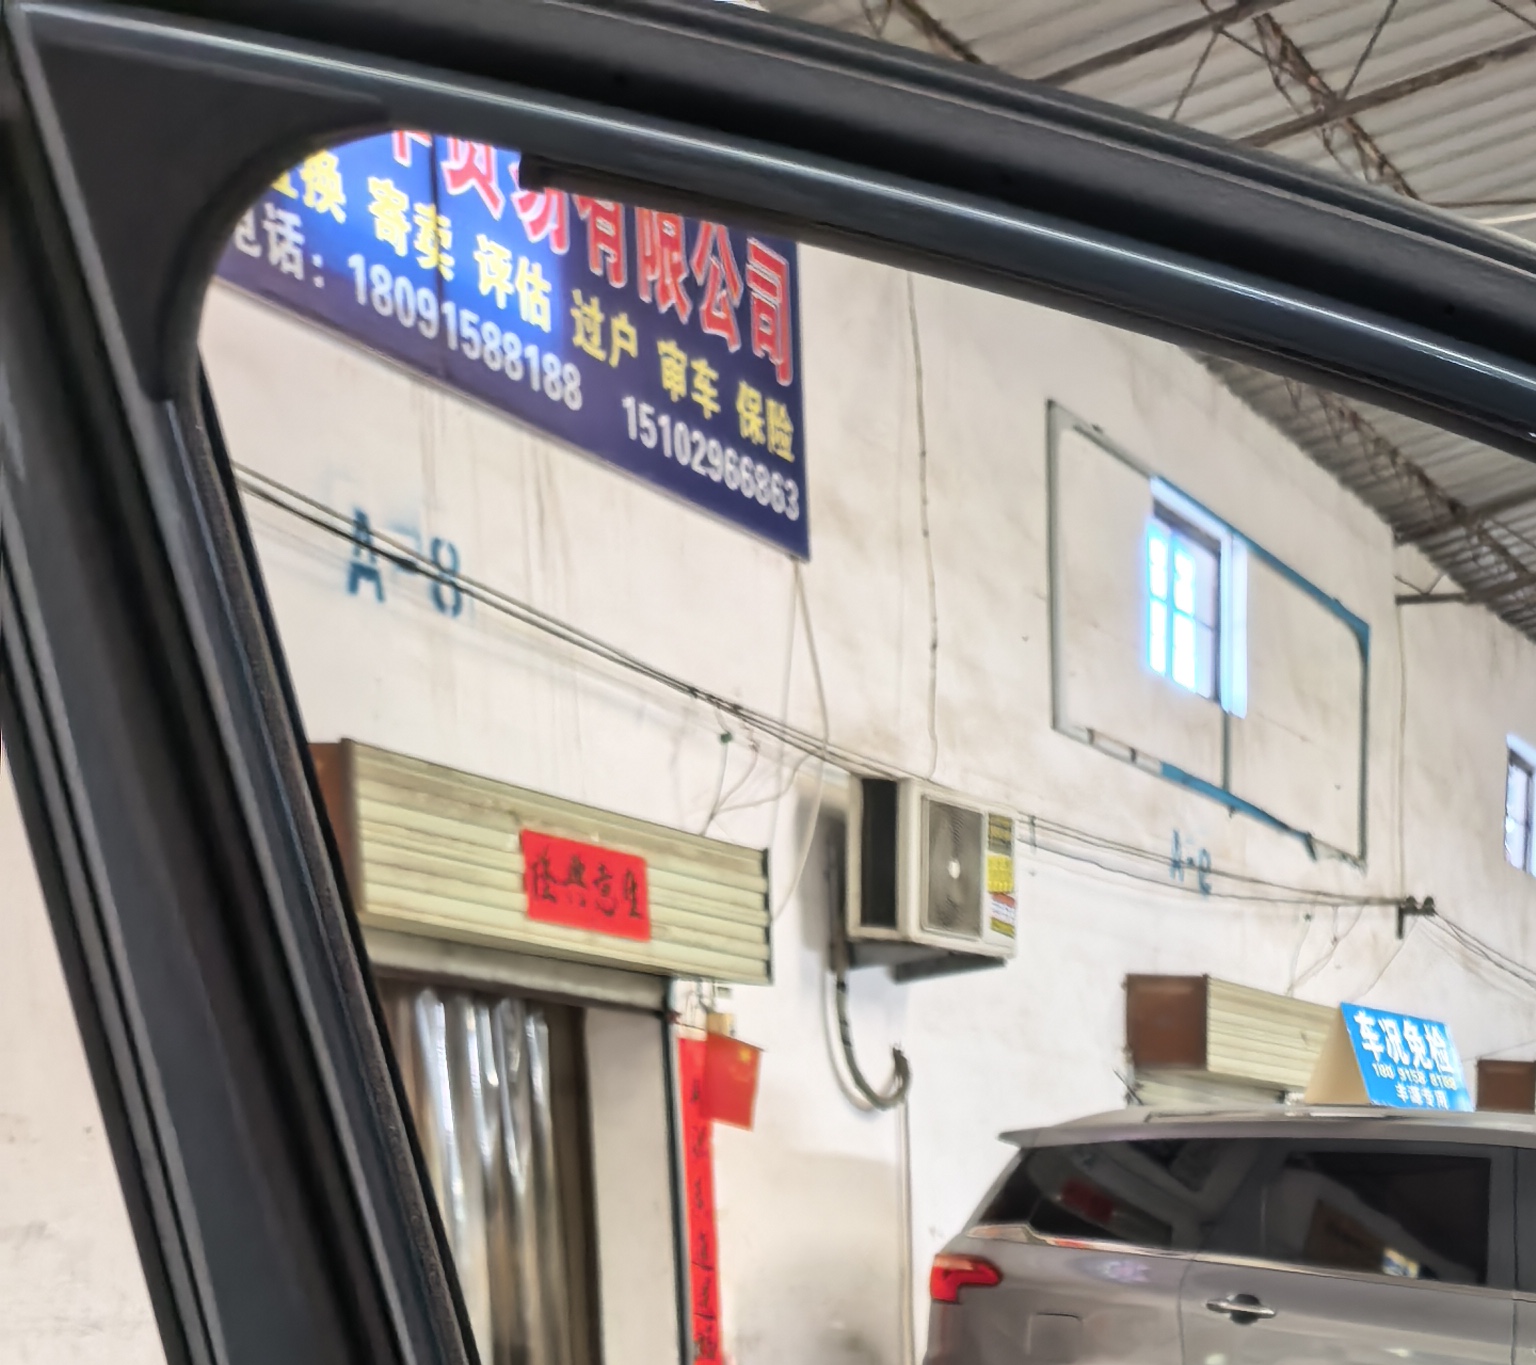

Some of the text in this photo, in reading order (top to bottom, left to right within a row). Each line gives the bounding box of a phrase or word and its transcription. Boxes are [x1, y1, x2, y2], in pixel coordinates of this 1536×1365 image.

[347, 254, 584, 411] 18091588188
[621, 396, 800, 521] 15102966863
[367, 176, 455, 282] 寄卖
[473, 233, 552, 333] 评估
[570, 288, 639, 369] 过户
[656, 338, 721, 420] 审车
[735, 380, 795, 463] 保险
[1353, 1009, 1455, 1074] 车况免检
